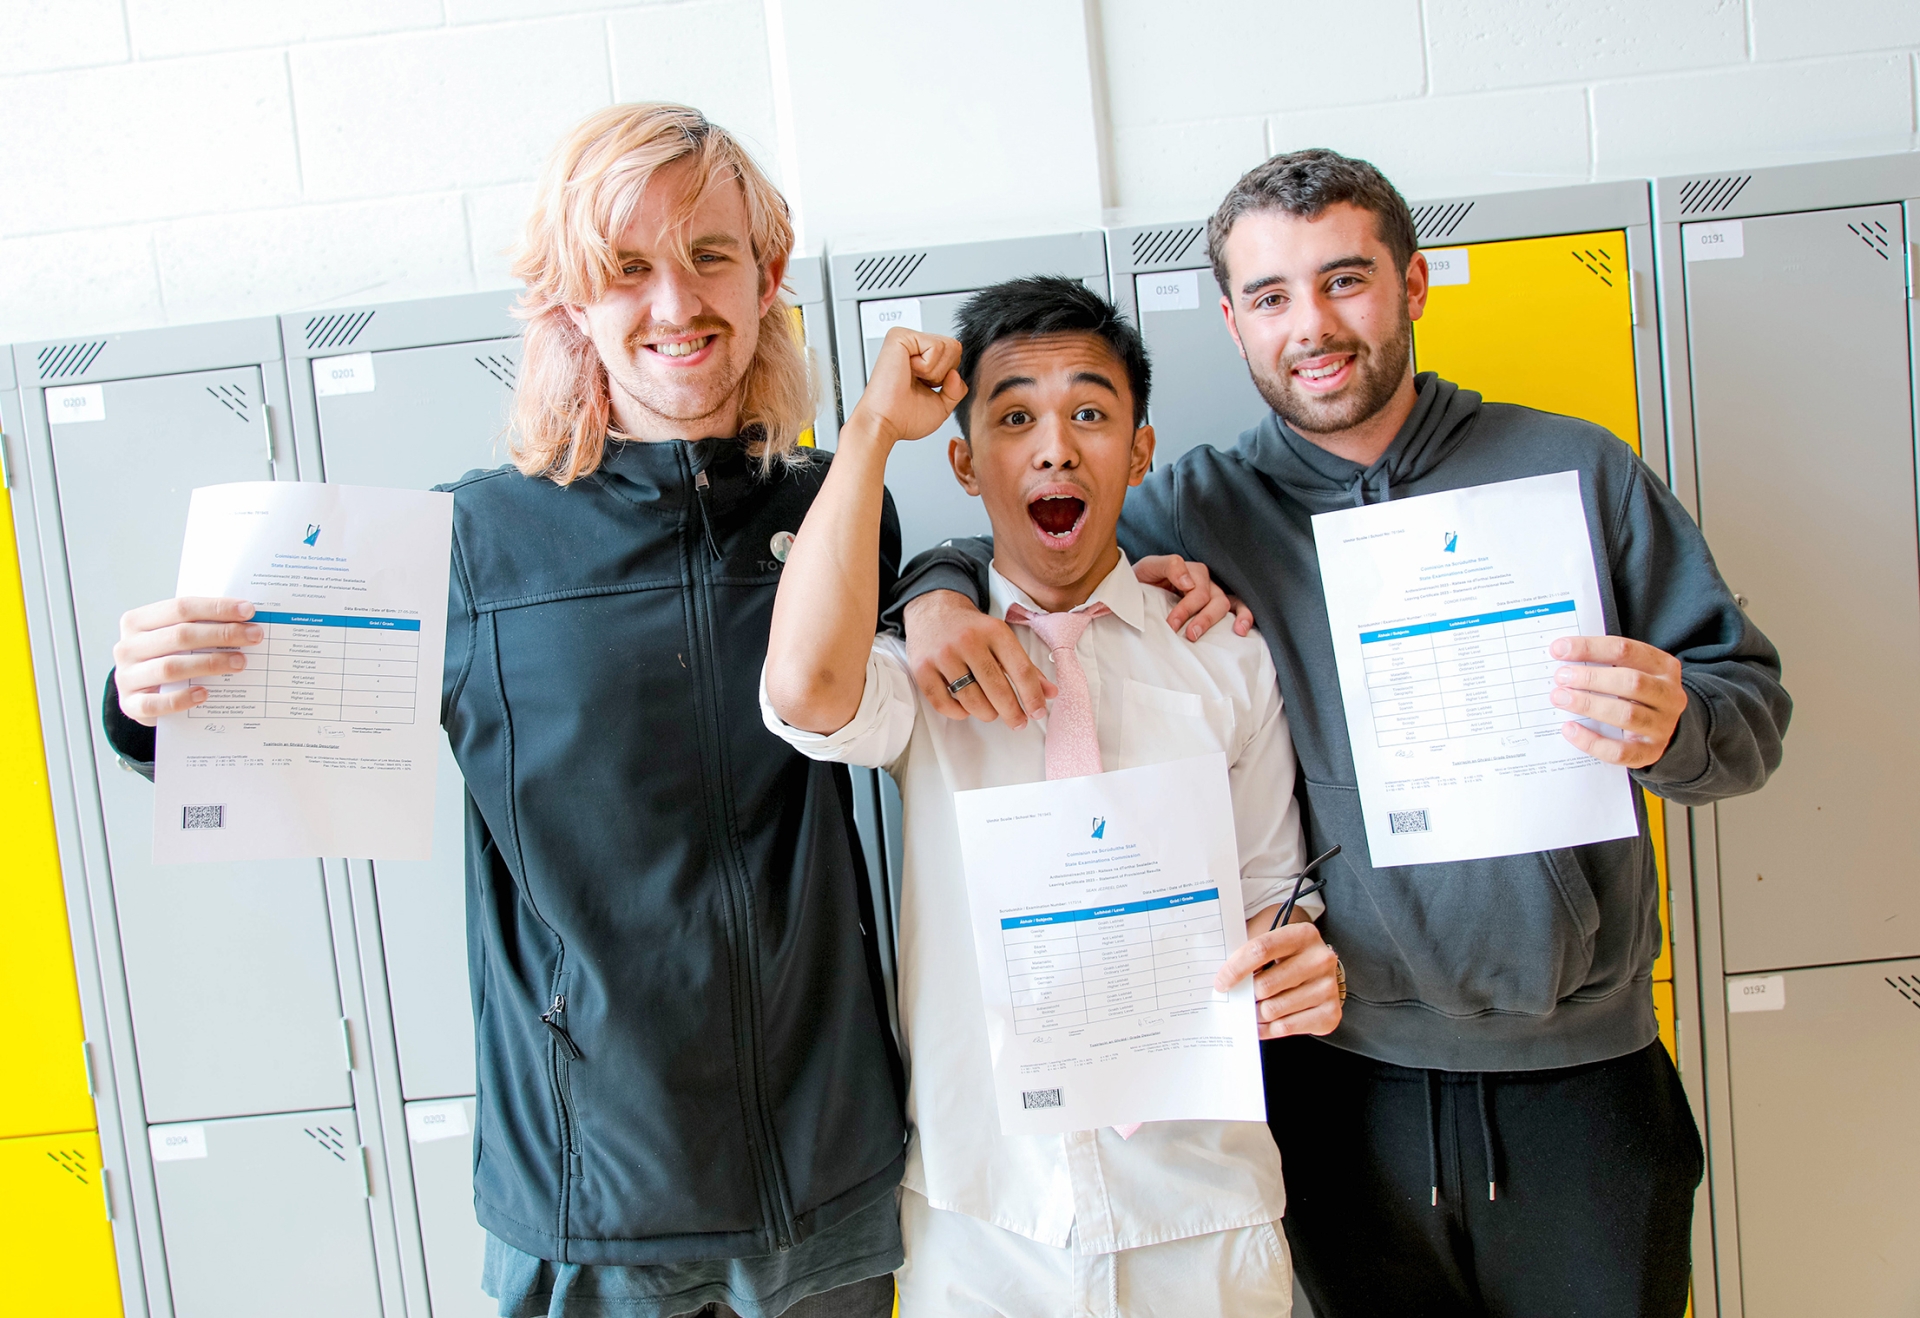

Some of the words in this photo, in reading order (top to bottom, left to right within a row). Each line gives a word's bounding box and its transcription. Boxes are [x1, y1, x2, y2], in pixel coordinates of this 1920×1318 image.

[1701, 234, 1724, 244] 0191
[1428, 262, 1450, 270] 0193
[1156, 285, 1179, 295] 0195
[879, 312, 902, 322] 0197
[332, 369, 354, 379] 0201
[64, 397, 86, 408] 0203
[1110, 852, 1140, 861] Commission
[1743, 985, 1766, 995] 0192
[423, 1114, 445, 1124] 0202
